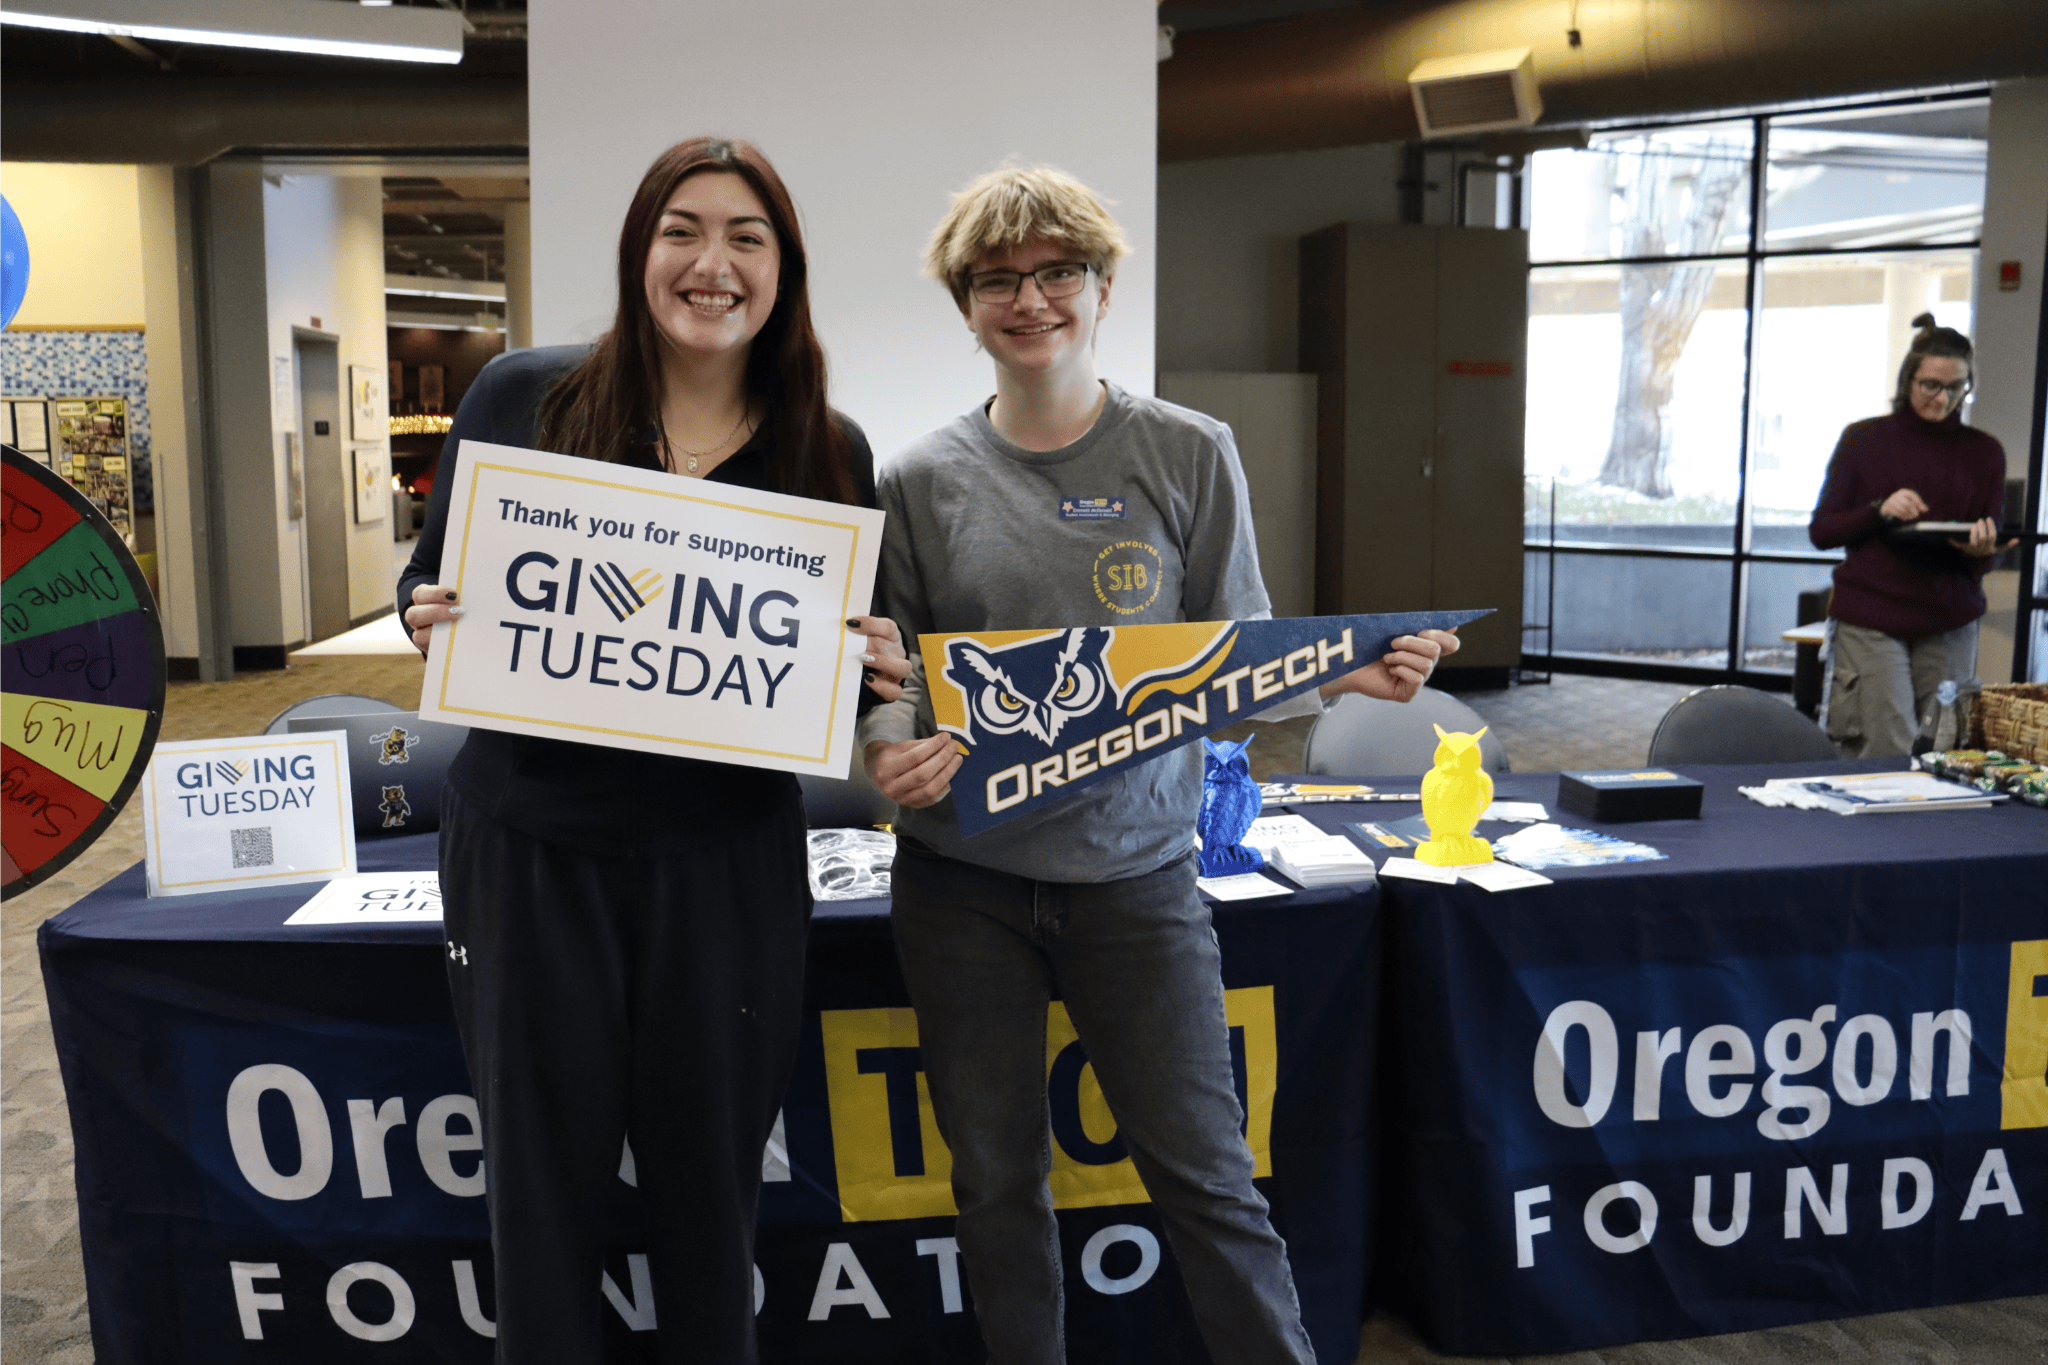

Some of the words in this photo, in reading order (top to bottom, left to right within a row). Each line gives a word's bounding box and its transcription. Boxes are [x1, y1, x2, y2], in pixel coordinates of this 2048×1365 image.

[499, 498, 579, 531] Thank
[588, 516, 634, 540] you
[644, 520, 680, 547] for
[687, 530, 827, 578] supporting
[1098, 545, 1114, 560] GET
[1116, 541, 1158, 556] INVOLVED
[18, 551, 120, 606] Phone
[1092, 574, 1108, 603] WHERE
[1106, 601, 1145, 616] STUDENTS
[1107, 563, 1148, 591] SIB
[17, 635, 117, 691] Pen
[500, 620, 794, 709] TUESDAY
[24, 700, 123, 770] Mug
[986, 692, 1208, 814] OREGON
[1212, 627, 1354, 714] TECH
[178, 785, 316, 818] TUESDAY
[1533, 1000, 1972, 1141] Oregon
[1513, 1148, 2024, 1269] FOUNDA
